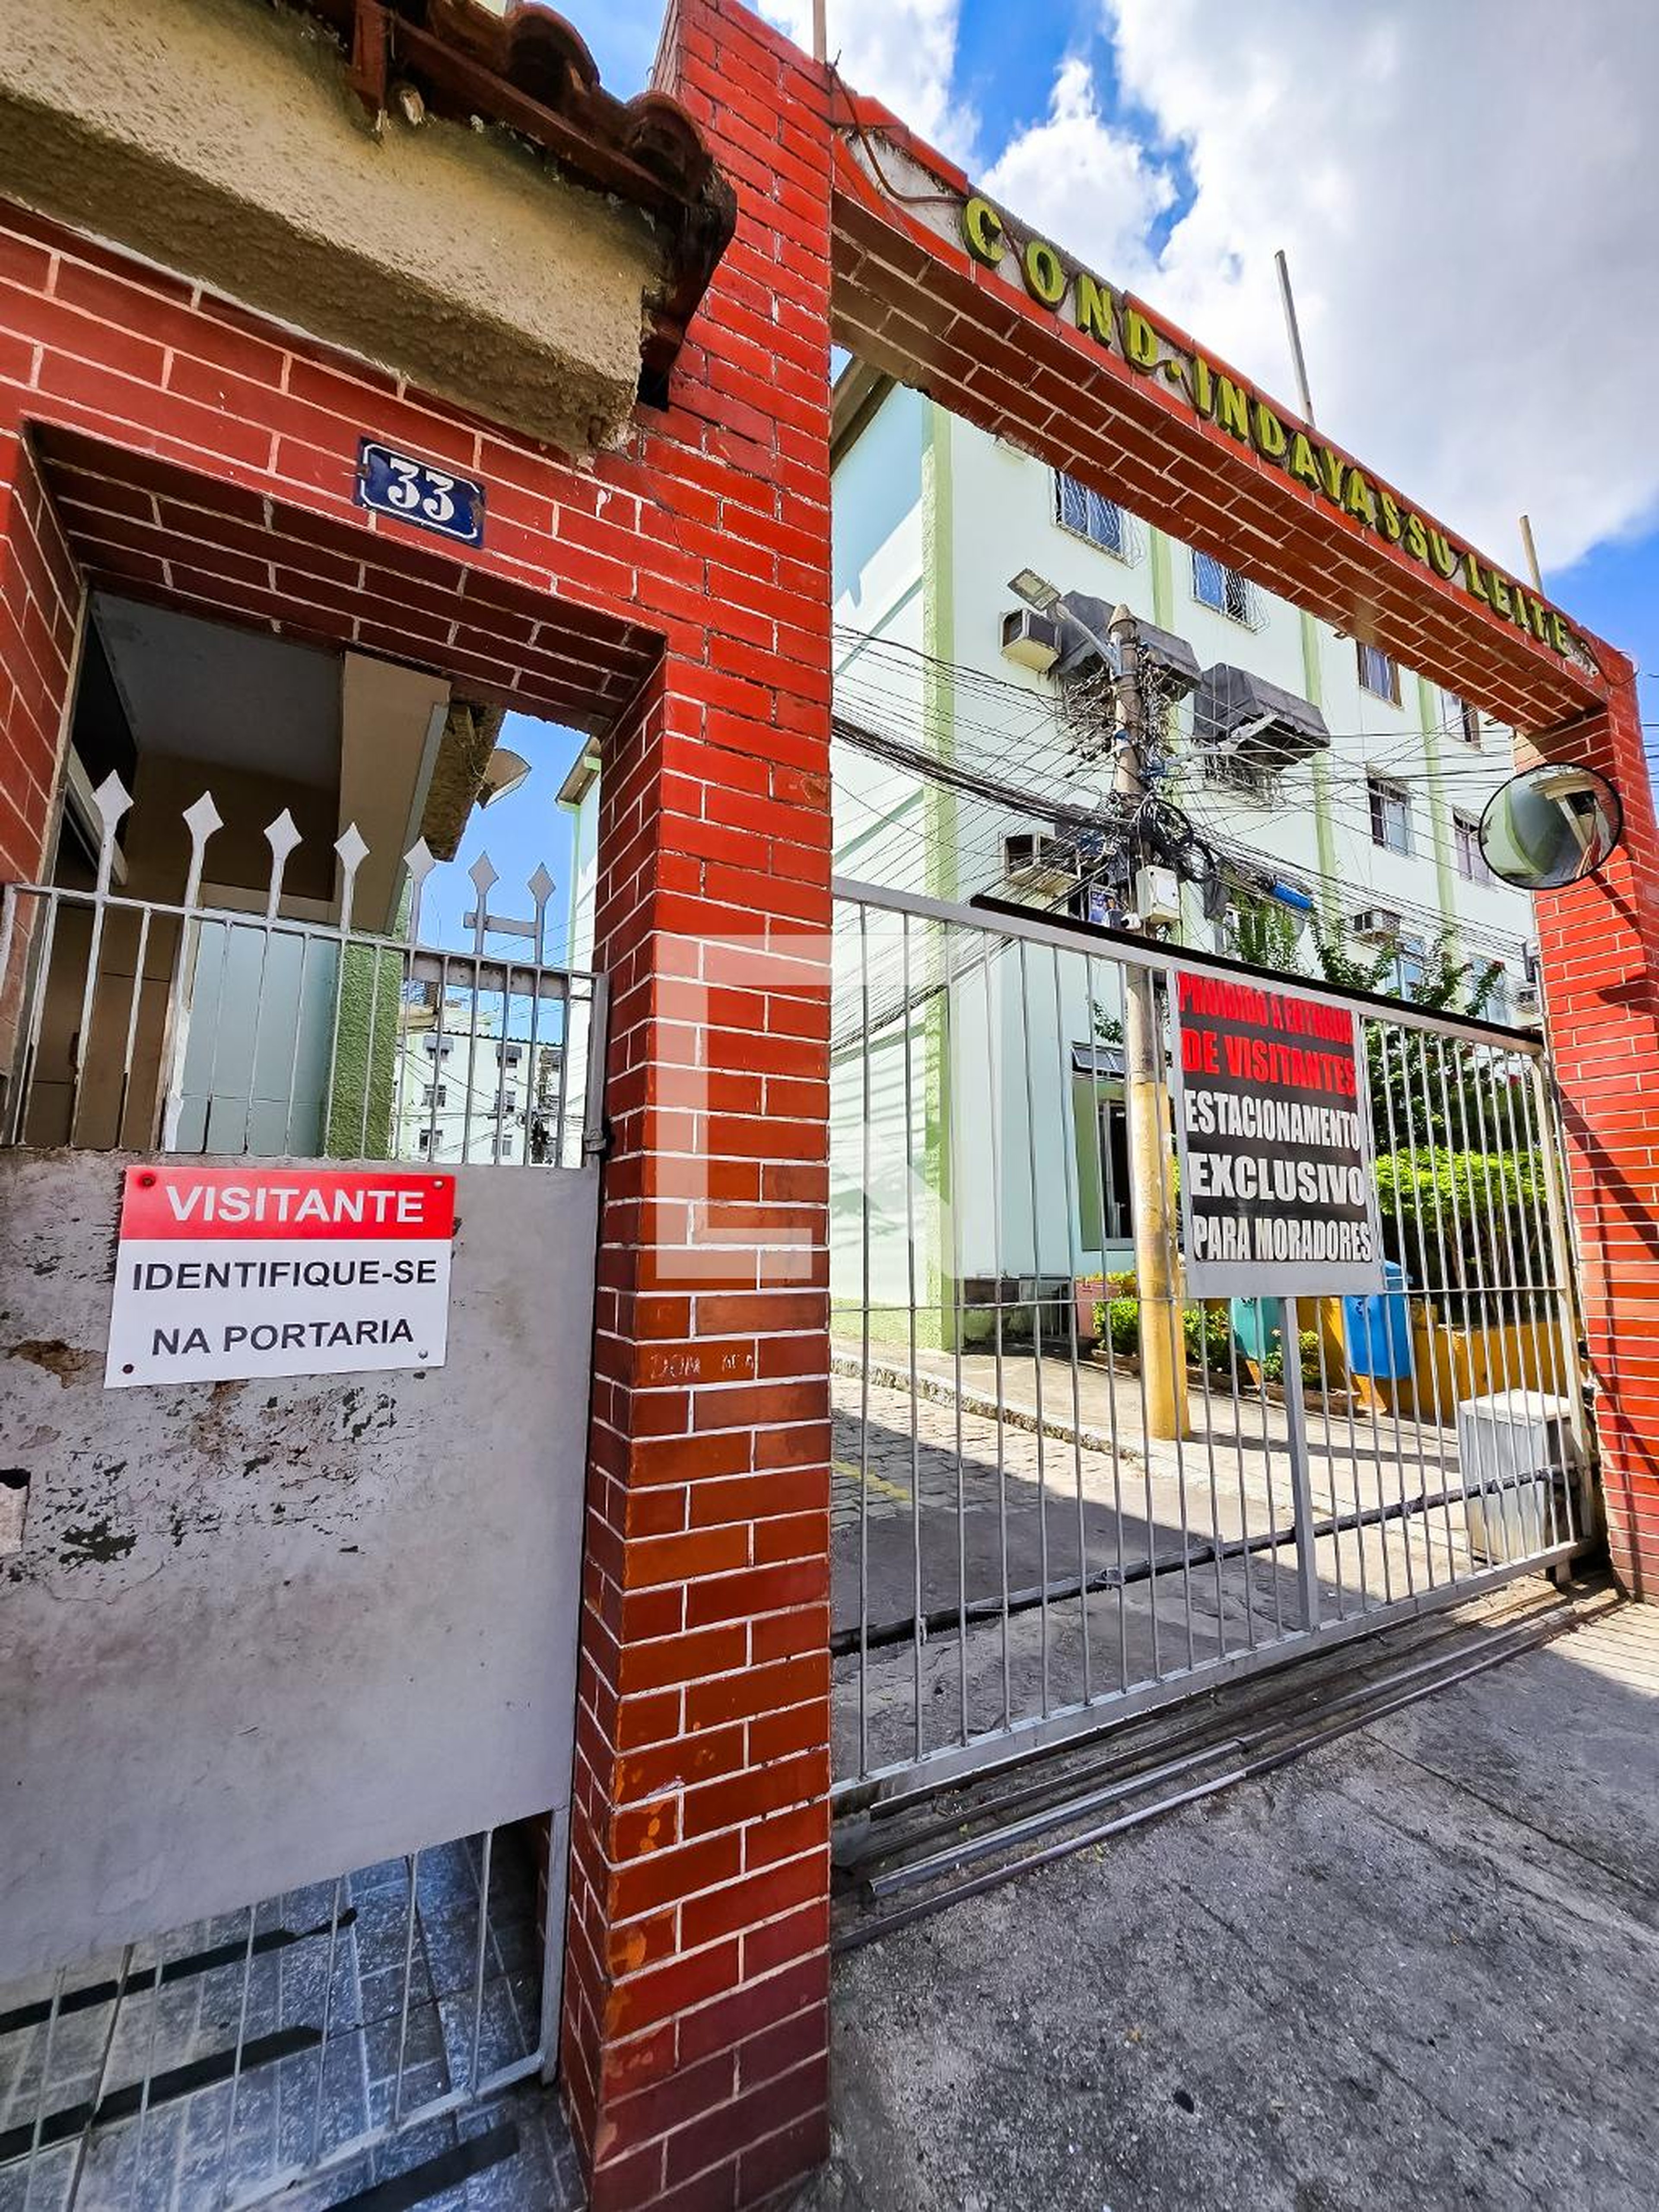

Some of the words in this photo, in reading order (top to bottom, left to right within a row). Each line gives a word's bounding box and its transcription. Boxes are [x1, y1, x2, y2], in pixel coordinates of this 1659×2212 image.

[388, 456, 454, 521] 33
[1192, 354, 1457, 580] INDAYASSU
[1462, 552, 1571, 657] LEITE
[1181, 1027, 1220, 1074] DE
[1225, 1034, 1356, 1097] VISITANTES
[1184, 1088, 1360, 1151] ESTACIONAMENTO
[166, 1186, 425, 1222] VISITANTE
[1187, 1152, 1366, 1206] EXCLUSIVO
[1192, 1215, 1251, 1260] PARA
[1254, 1217, 1373, 1262] MORADORES
[132, 1260, 437, 1290] IDENTIFIQUE-SE
[152, 1328, 210, 1356] NA
[223, 1318, 413, 1352] PORTARIA
